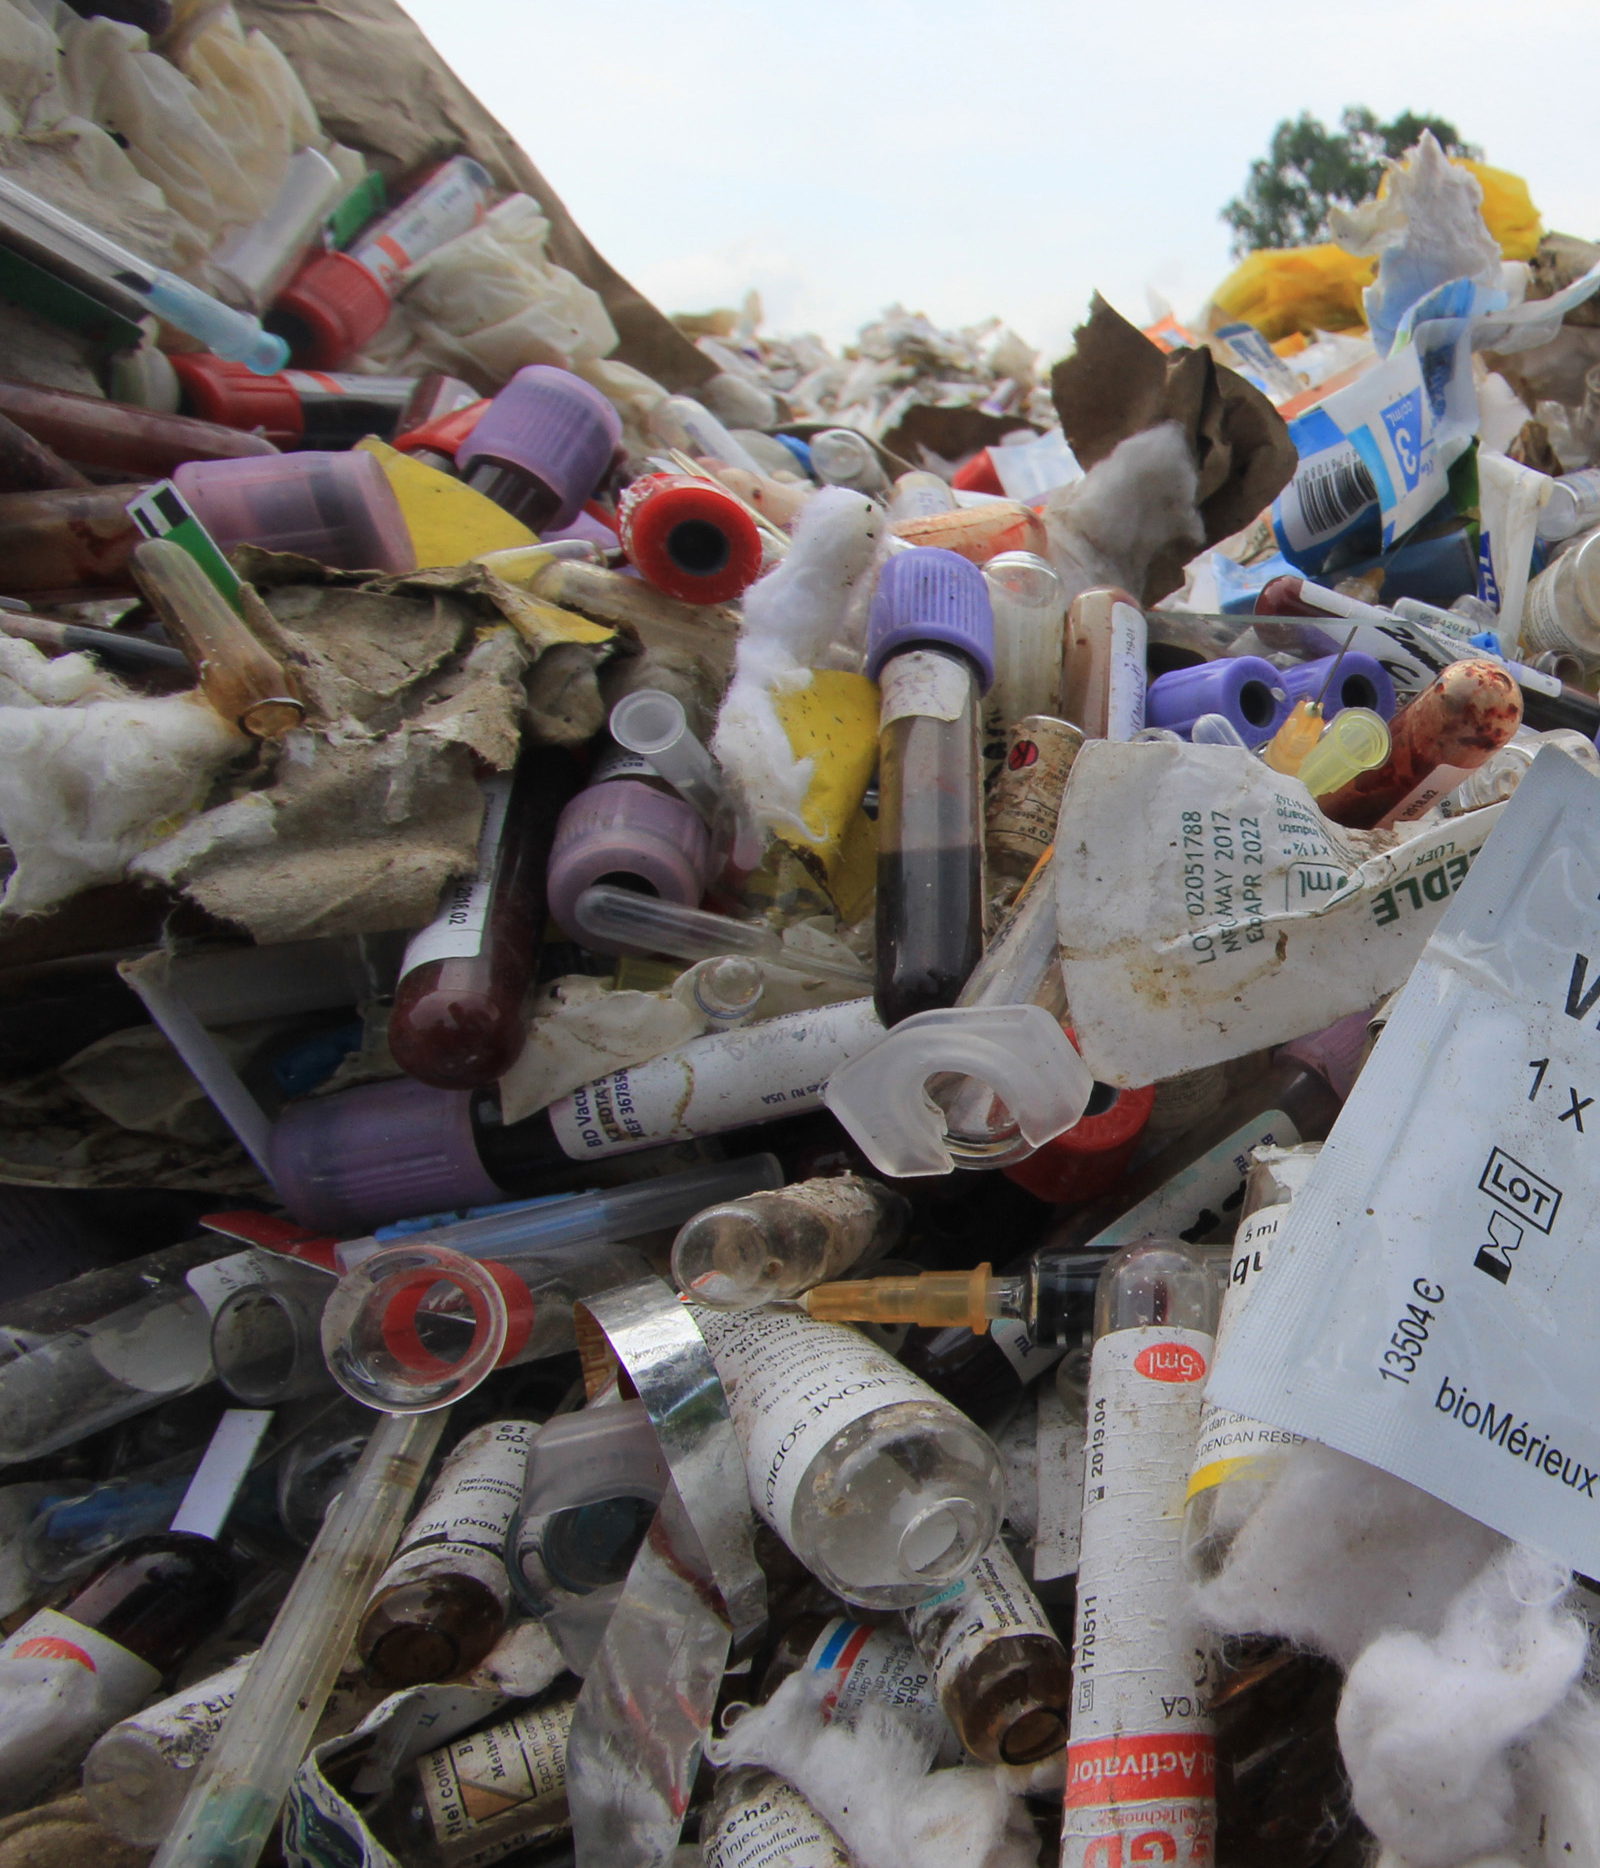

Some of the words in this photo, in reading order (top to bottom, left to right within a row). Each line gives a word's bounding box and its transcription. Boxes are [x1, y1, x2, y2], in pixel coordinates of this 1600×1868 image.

[1210, 810, 1234, 861] 2017
[1240, 816, 1262, 866] 2022
[1181, 811, 1206, 917] 02051788
[1214, 869, 1234, 917] MAY
[1528, 1057, 1550, 1102] 1
[585, 1127, 602, 1148] BD
[1492, 1163, 1551, 1216] LOT
[1149, 1351, 1195, 1375] 5ml
[1377, 1302, 1437, 1385] 13504
[1090, 1397, 1107, 1479] 2019.04
[1199, 1430, 1255, 1458] DENGAN
[1081, 1595, 1098, 1674] 170511
[536, 1761, 554, 1794] Each
[1071, 1751, 1196, 1784] Activator
[441, 1803, 463, 1835] Net
